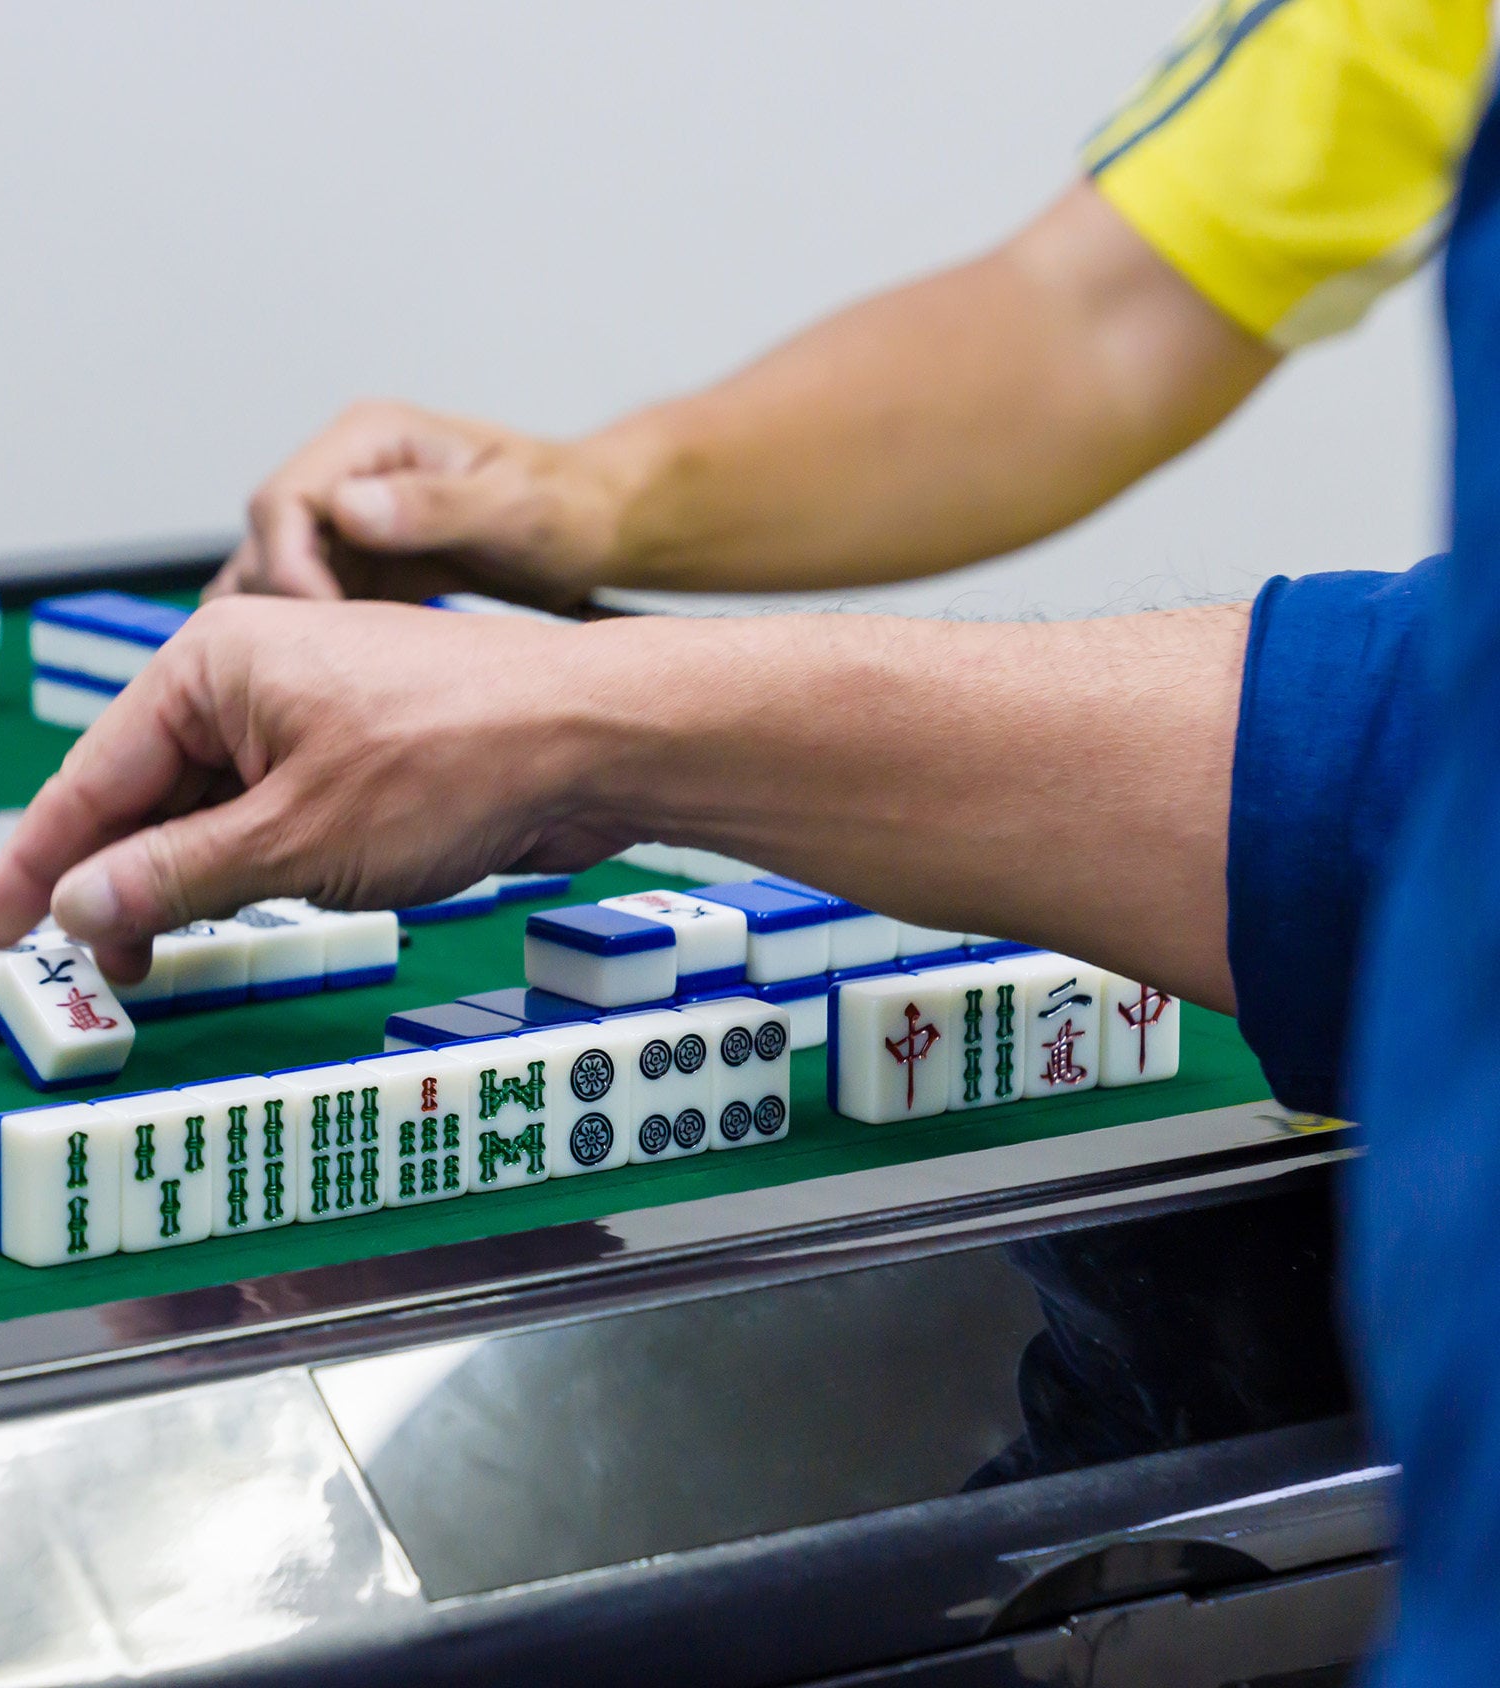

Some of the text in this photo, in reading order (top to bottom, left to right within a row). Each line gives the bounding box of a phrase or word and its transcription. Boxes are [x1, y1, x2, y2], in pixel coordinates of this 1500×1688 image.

[885, 1002, 941, 1111] 中
[1038, 977, 1092, 1086] 二萬
[1118, 985, 1172, 1074] 中
